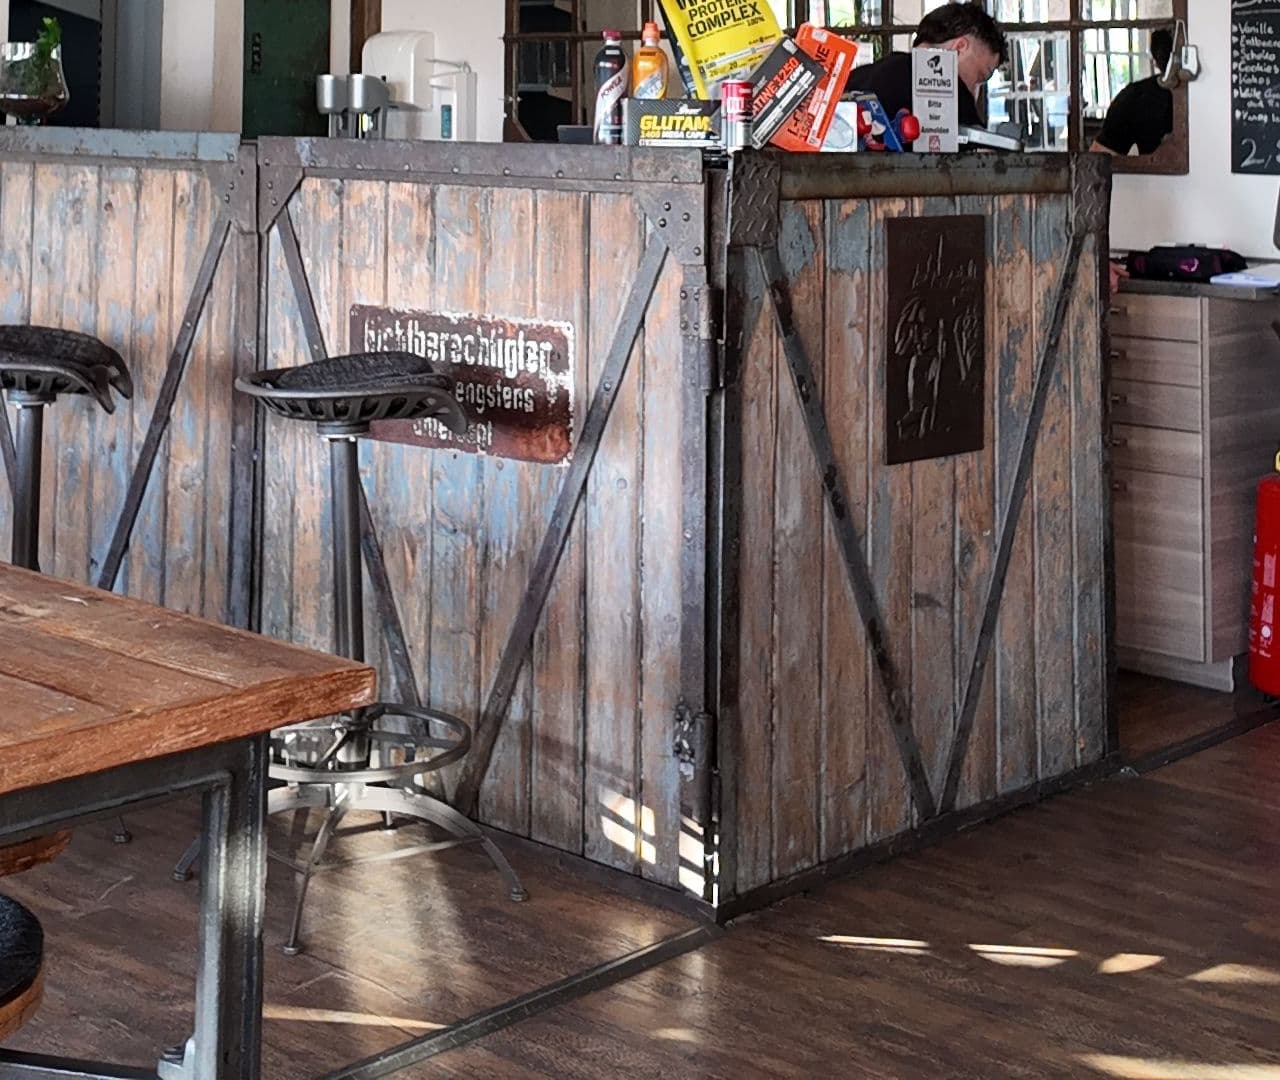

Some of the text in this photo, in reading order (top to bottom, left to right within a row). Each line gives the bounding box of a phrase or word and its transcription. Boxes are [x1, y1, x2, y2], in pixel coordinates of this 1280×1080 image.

[686, 1, 762, 39] COMPLEX
[774, 56, 800, 87] 1250
[918, 77, 952, 88] ACHTUNG
[752, 81, 779, 116] ATINE
[640, 114, 710, 132] GLUTAM
[455, 380, 535, 414] engstens
